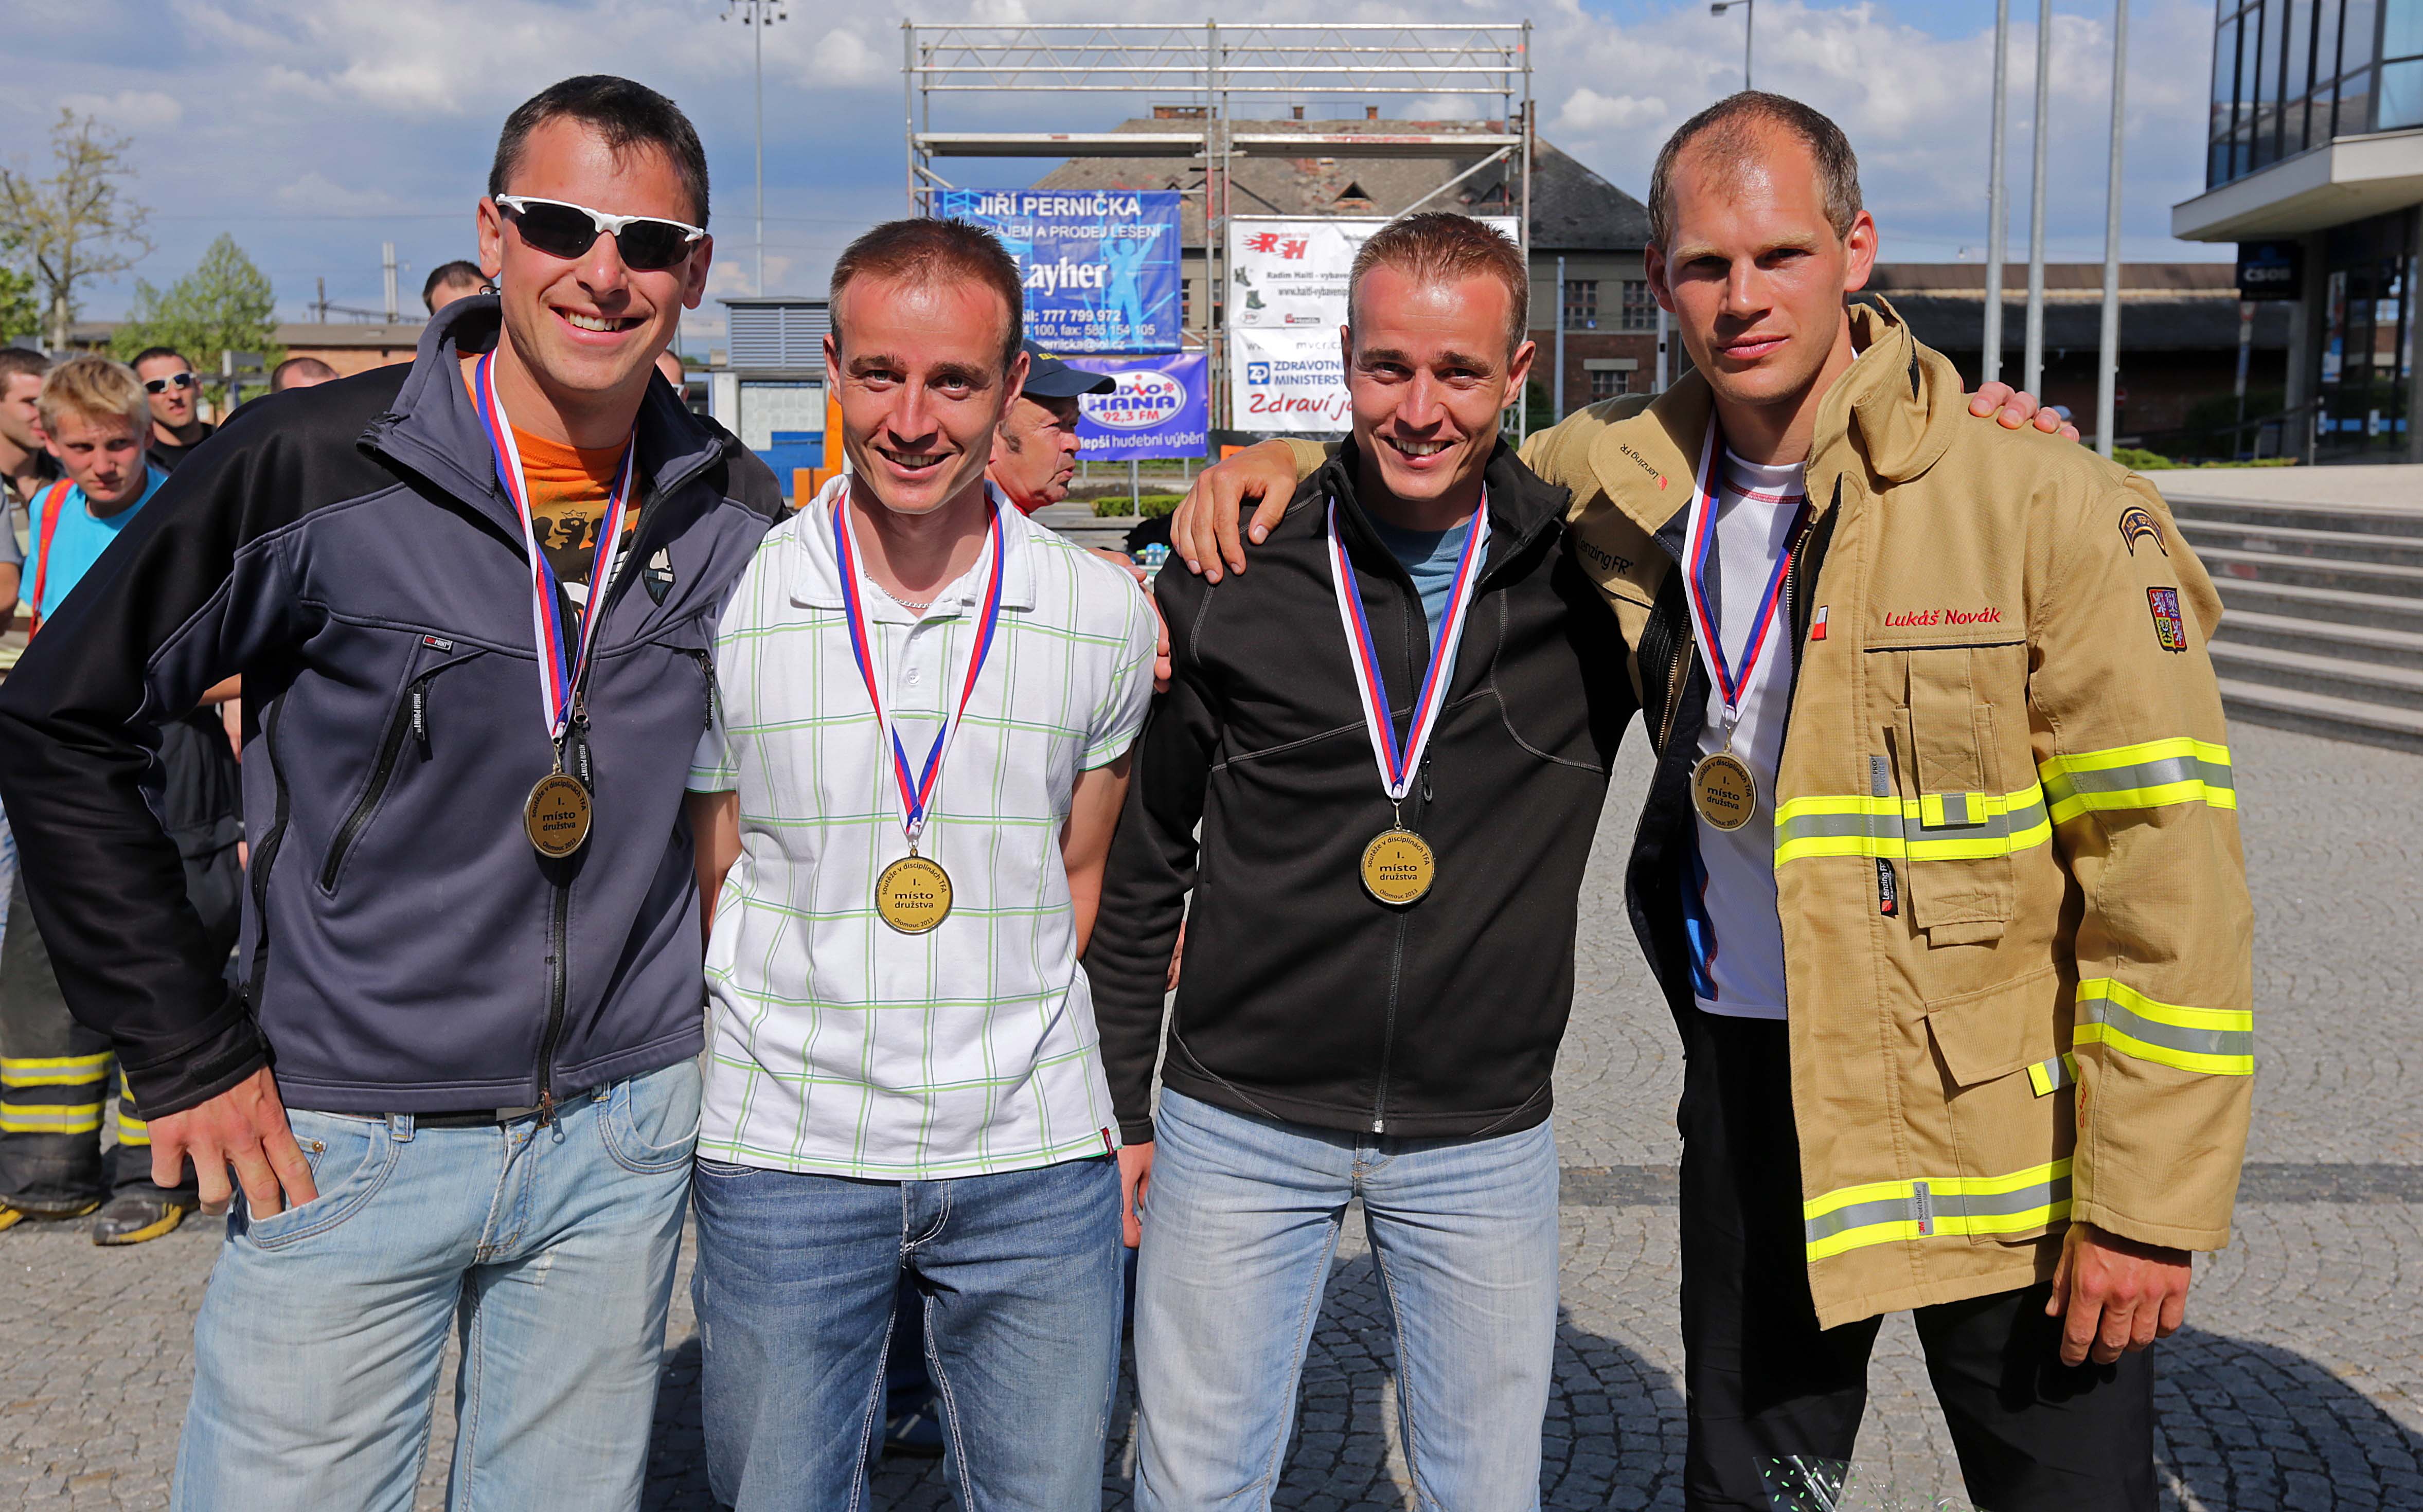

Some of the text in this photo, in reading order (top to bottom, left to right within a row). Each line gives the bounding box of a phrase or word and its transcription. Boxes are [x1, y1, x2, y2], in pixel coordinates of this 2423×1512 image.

[974, 192, 1142, 216] JIŘÍ PERNIČKA
[1036, 226, 1048, 238] A
[1049, 225, 1107, 238] PRODEJ
[1110, 222, 1161, 238] LEŠENÍ
[1023, 256, 1109, 297] ayher
[1042, 309, 1066, 322] 777
[1070, 309, 1094, 322] 799
[1096, 309, 1121, 322] 972
[1034, 323, 1058, 337] 100,
[1060, 323, 1082, 336] fax:
[1111, 324, 1130, 336] 154
[1135, 323, 1156, 336] 105
[1088, 396, 1175, 411] HANA
[1250, 392, 1334, 413] Zdraví
[1103, 410, 1160, 422] 92,3 FM
[1078, 431, 1205, 451] lepší hudební výběr!
[1620, 443, 1659, 480] Lenzing FR
[1578, 533, 1612, 570] Lenzing
[1885, 607, 2002, 627] Lukáš Novák
[578, 744, 586, 759] HIGH
[1716, 759, 1747, 783] disciplínách
[549, 780, 580, 798] disciplínách
[1707, 787, 1740, 801] místo
[1707, 796, 1739, 810] družstva
[543, 811, 576, 821] místo
[1705, 811, 1726, 826] Olomouc
[543, 822, 576, 831] družstva
[565, 838, 577, 849] 2013
[1367, 844, 1382, 868] soutěže
[1387, 836, 1423, 853] disciplínách
[1422, 853, 1430, 866] TFA
[882, 870, 898, 895] soutěže
[903, 862, 940, 880] disciplínách
[939, 880, 947, 893] TFA
[1881, 872, 1890, 900] Lenzing
[895, 891, 934, 899] místo
[1380, 889, 1418, 899] Olomouc 2013
[894, 917, 934, 928] Olomouc 2013
[1919, 1221, 1925, 1233] 3M
